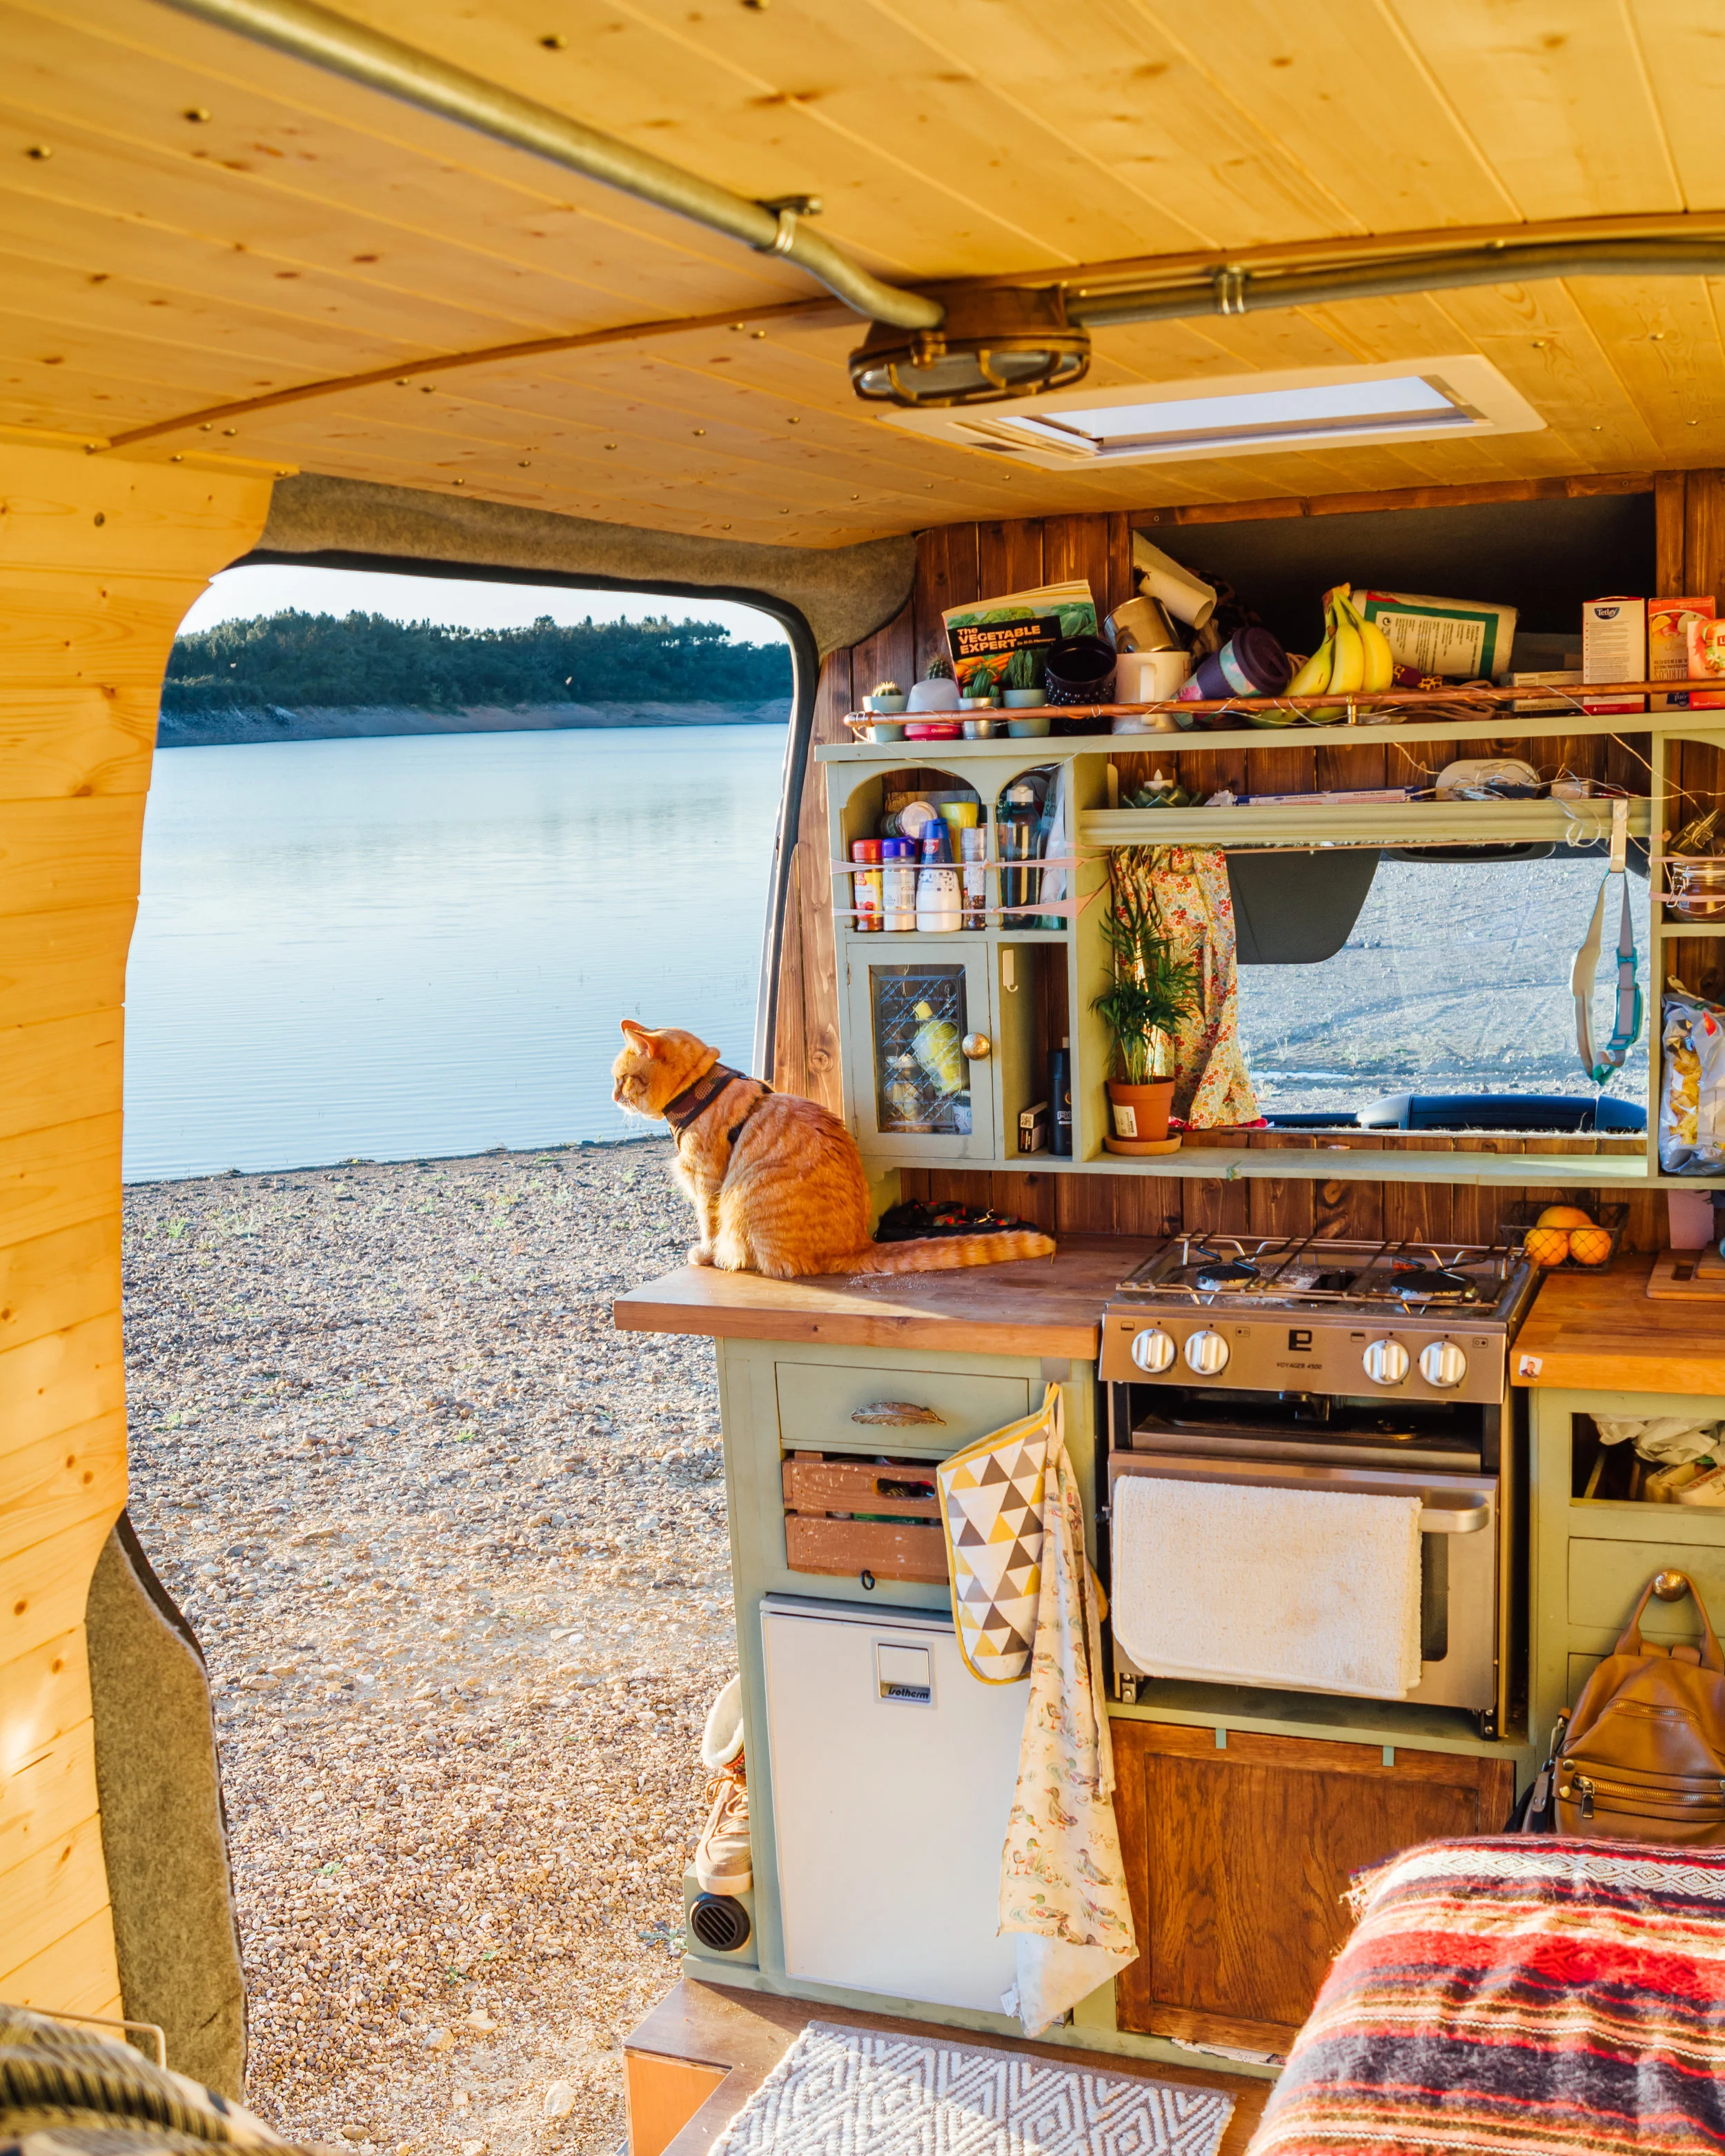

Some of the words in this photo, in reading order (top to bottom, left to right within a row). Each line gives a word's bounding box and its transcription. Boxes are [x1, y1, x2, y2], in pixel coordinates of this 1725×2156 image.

[1597, 609, 1617, 617] Tetley
[957, 627, 978, 635] The
[958, 625, 1041, 644] VEGETABLE
[959, 638, 1016, 655] EXPERT
[889, 1686, 929, 1699] isotherm
